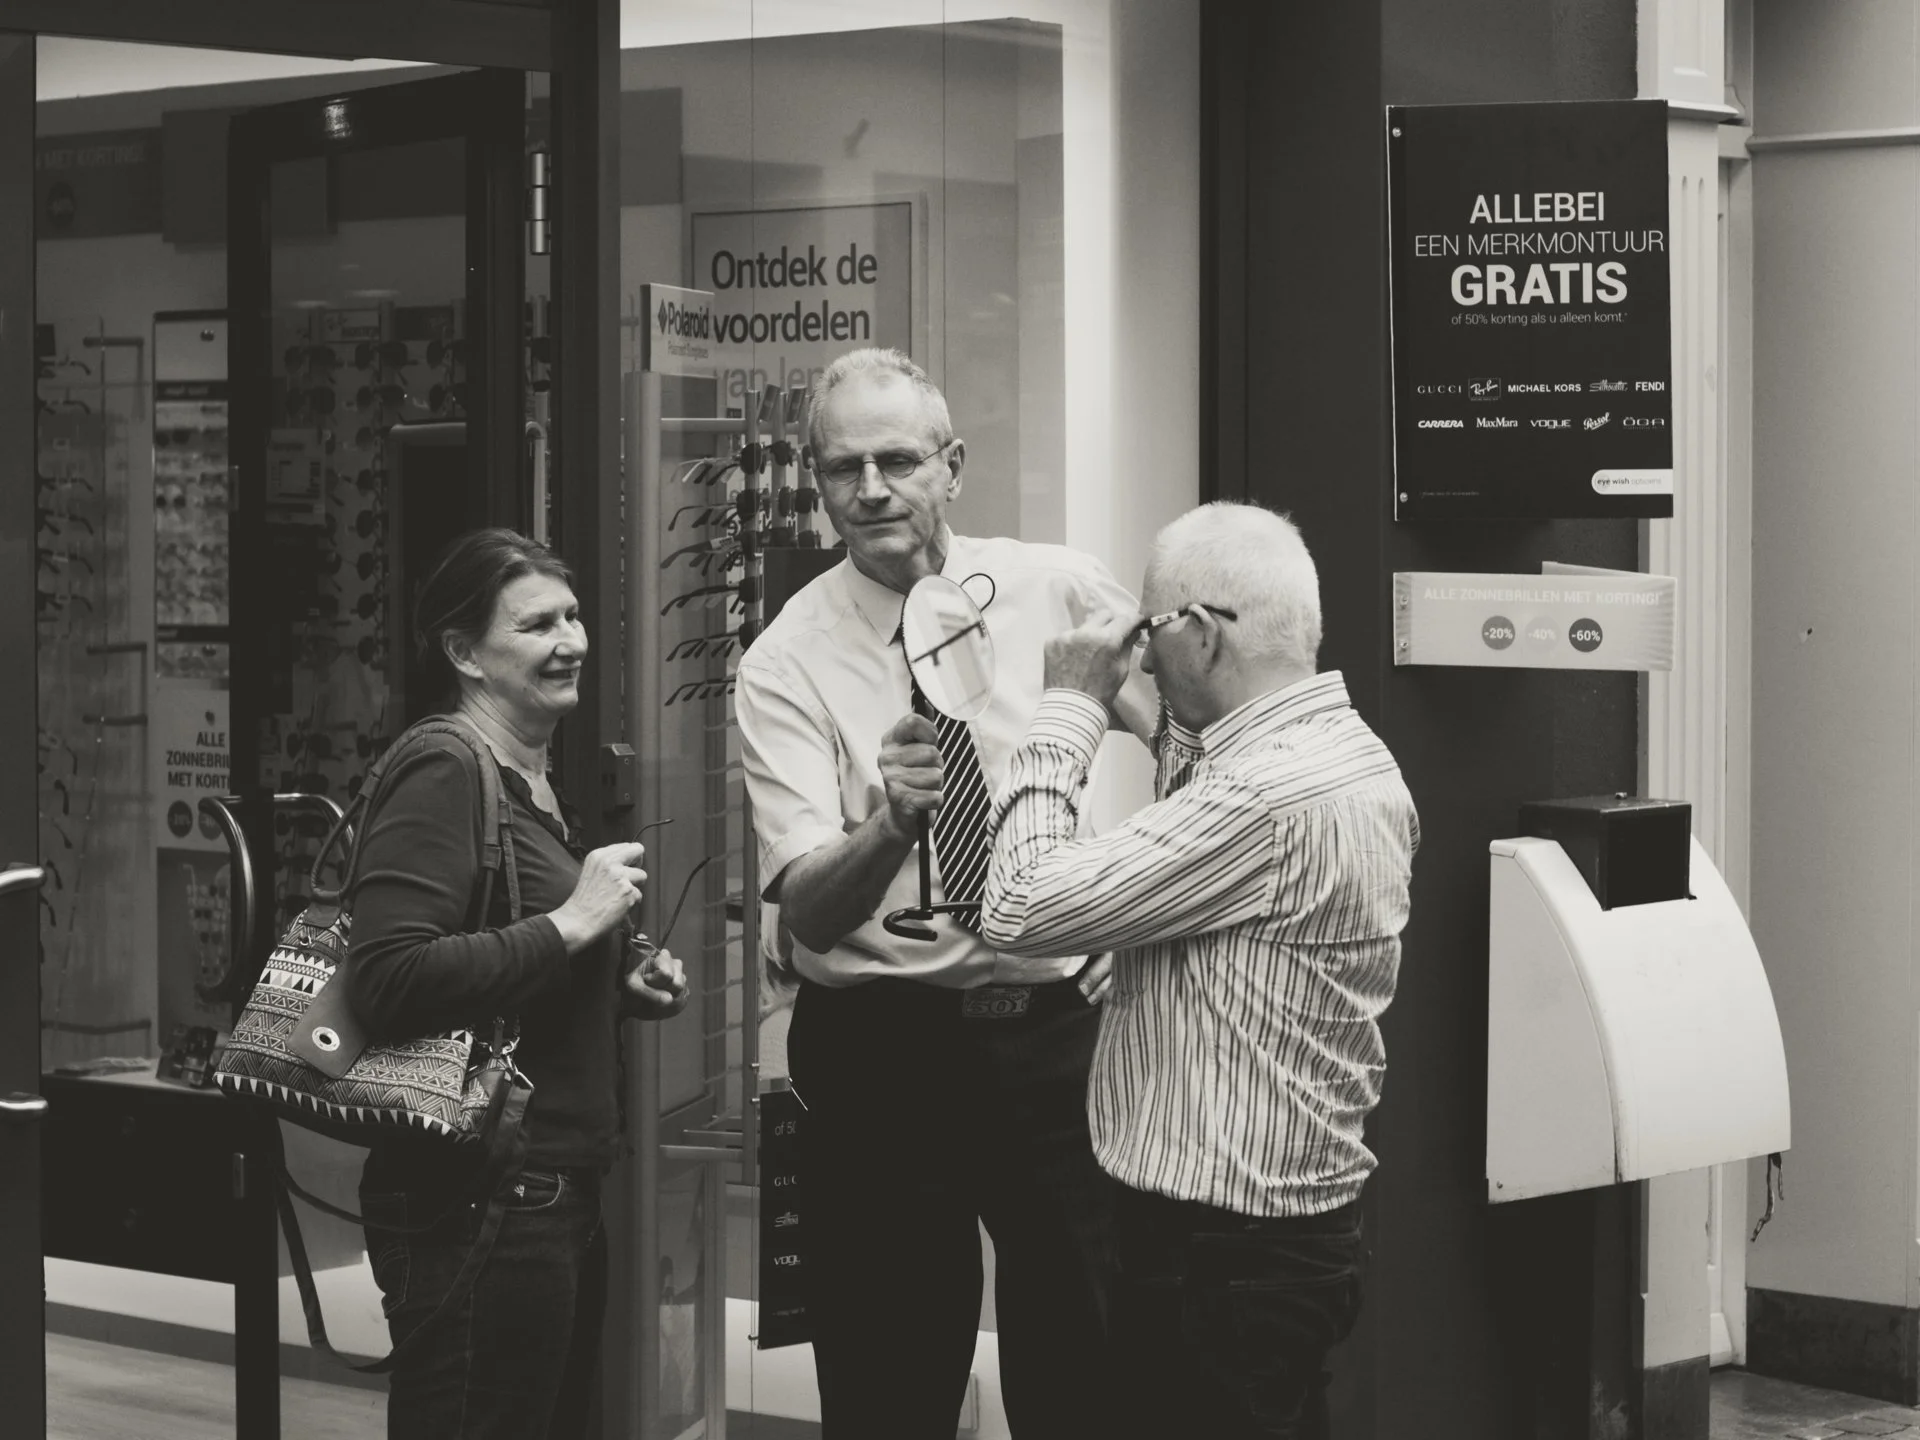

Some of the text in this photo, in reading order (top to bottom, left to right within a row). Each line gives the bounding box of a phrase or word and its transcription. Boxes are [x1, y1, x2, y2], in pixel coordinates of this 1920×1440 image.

[1469, 191, 1605, 224] ALLEBEI
[1414, 230, 1665, 257] EEN MERKMONTUUR
[711, 242, 878, 290] Ontdek de
[1451, 261, 1628, 306] GRATIS
[667, 301, 710, 340] Polaroid
[712, 299, 871, 344] voordelen
[1451, 313, 1462, 325] of
[1465, 313, 1489, 325] 50%
[1491, 313, 1529, 327] korting
[1530, 312, 1547, 324] als
[1549, 314, 1557, 323] u
[1559, 311, 1592, 323] alleen
[1417, 384, 1462, 394] GUCCI
[1507, 383, 1582, 393] MICHAEL KORS
[1635, 381, 1665, 392] FENDI
[1418, 419, 1464, 428] CARRERA
[1476, 417, 1518, 428] MaxMara
[1597, 478, 1611, 487] eye
[1612, 476, 1630, 486] wish
[1424, 587, 1457, 601] ALLE
[1460, 588, 1560, 603] ZONNEBRILLEN
[1563, 590, 1593, 604] MET
[1483, 627, 1601, 642] -20% -40% -60%
[196, 731, 226, 748] ALLE
[167, 771, 192, 787] MET
[774, 1121, 785, 1136] of
